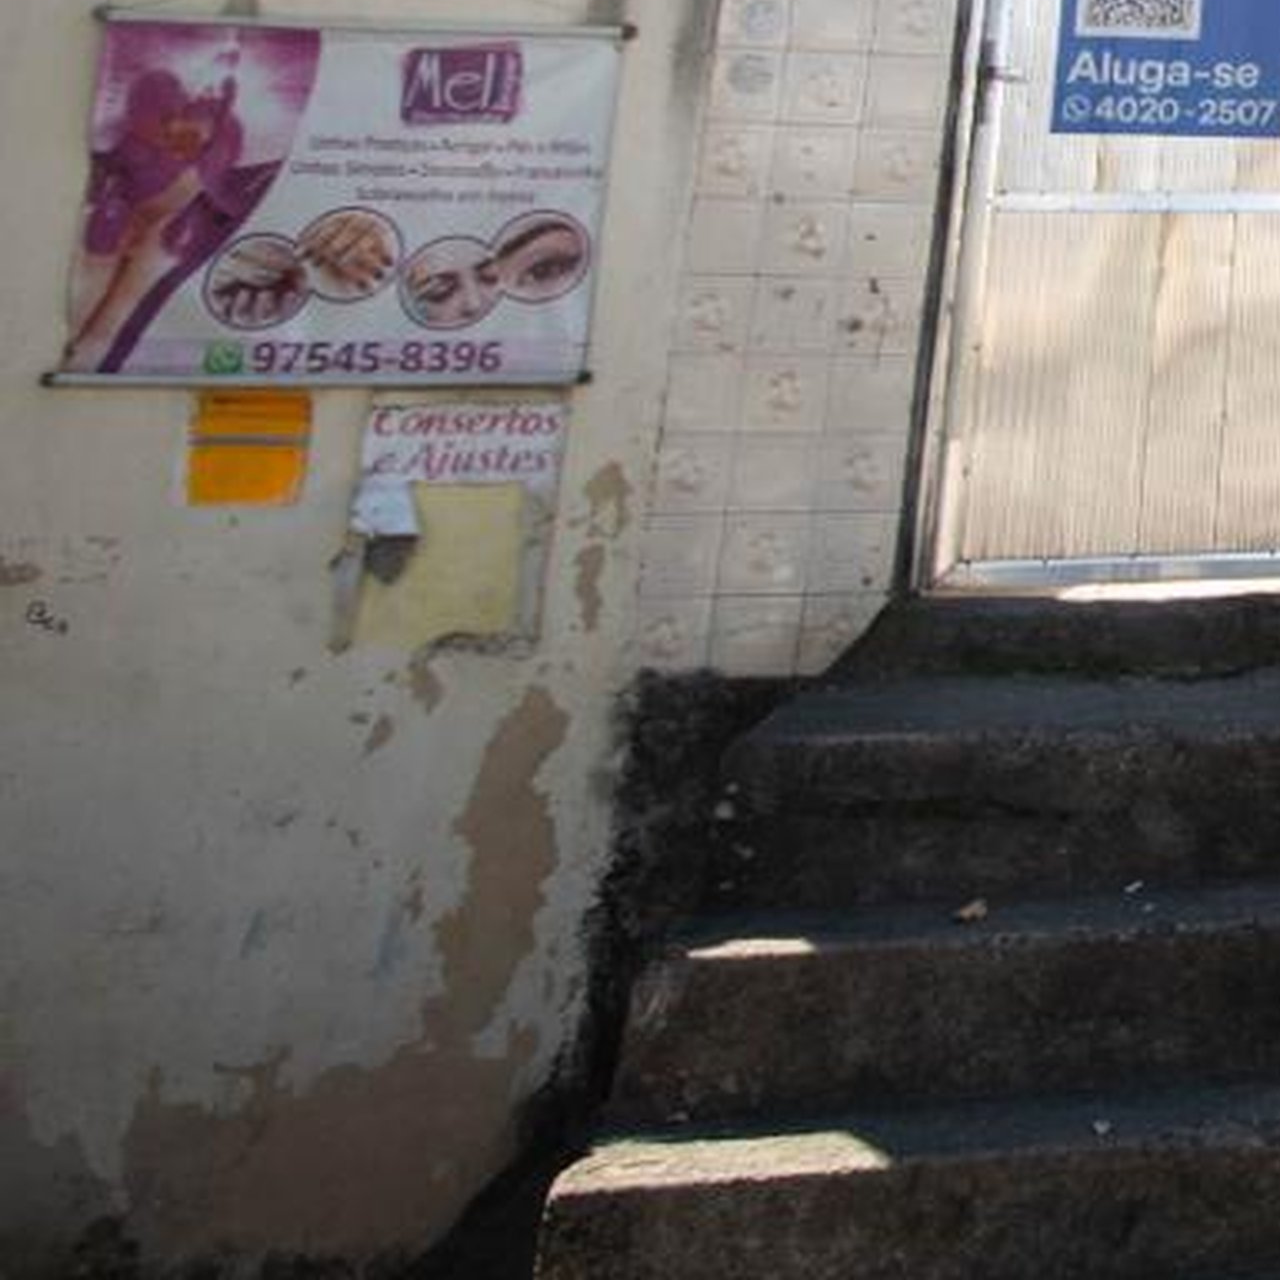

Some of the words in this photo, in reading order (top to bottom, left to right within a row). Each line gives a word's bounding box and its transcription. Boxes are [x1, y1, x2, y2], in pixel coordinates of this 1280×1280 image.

[1066, 49, 1261, 94] Aluga-se
[1094, 95, 1278, 127] 4020-2507
[252, 341, 503, 373] 97545-8396
[372, 404, 560, 437] Consertos
[403, 442, 549, 480] Ajustes
